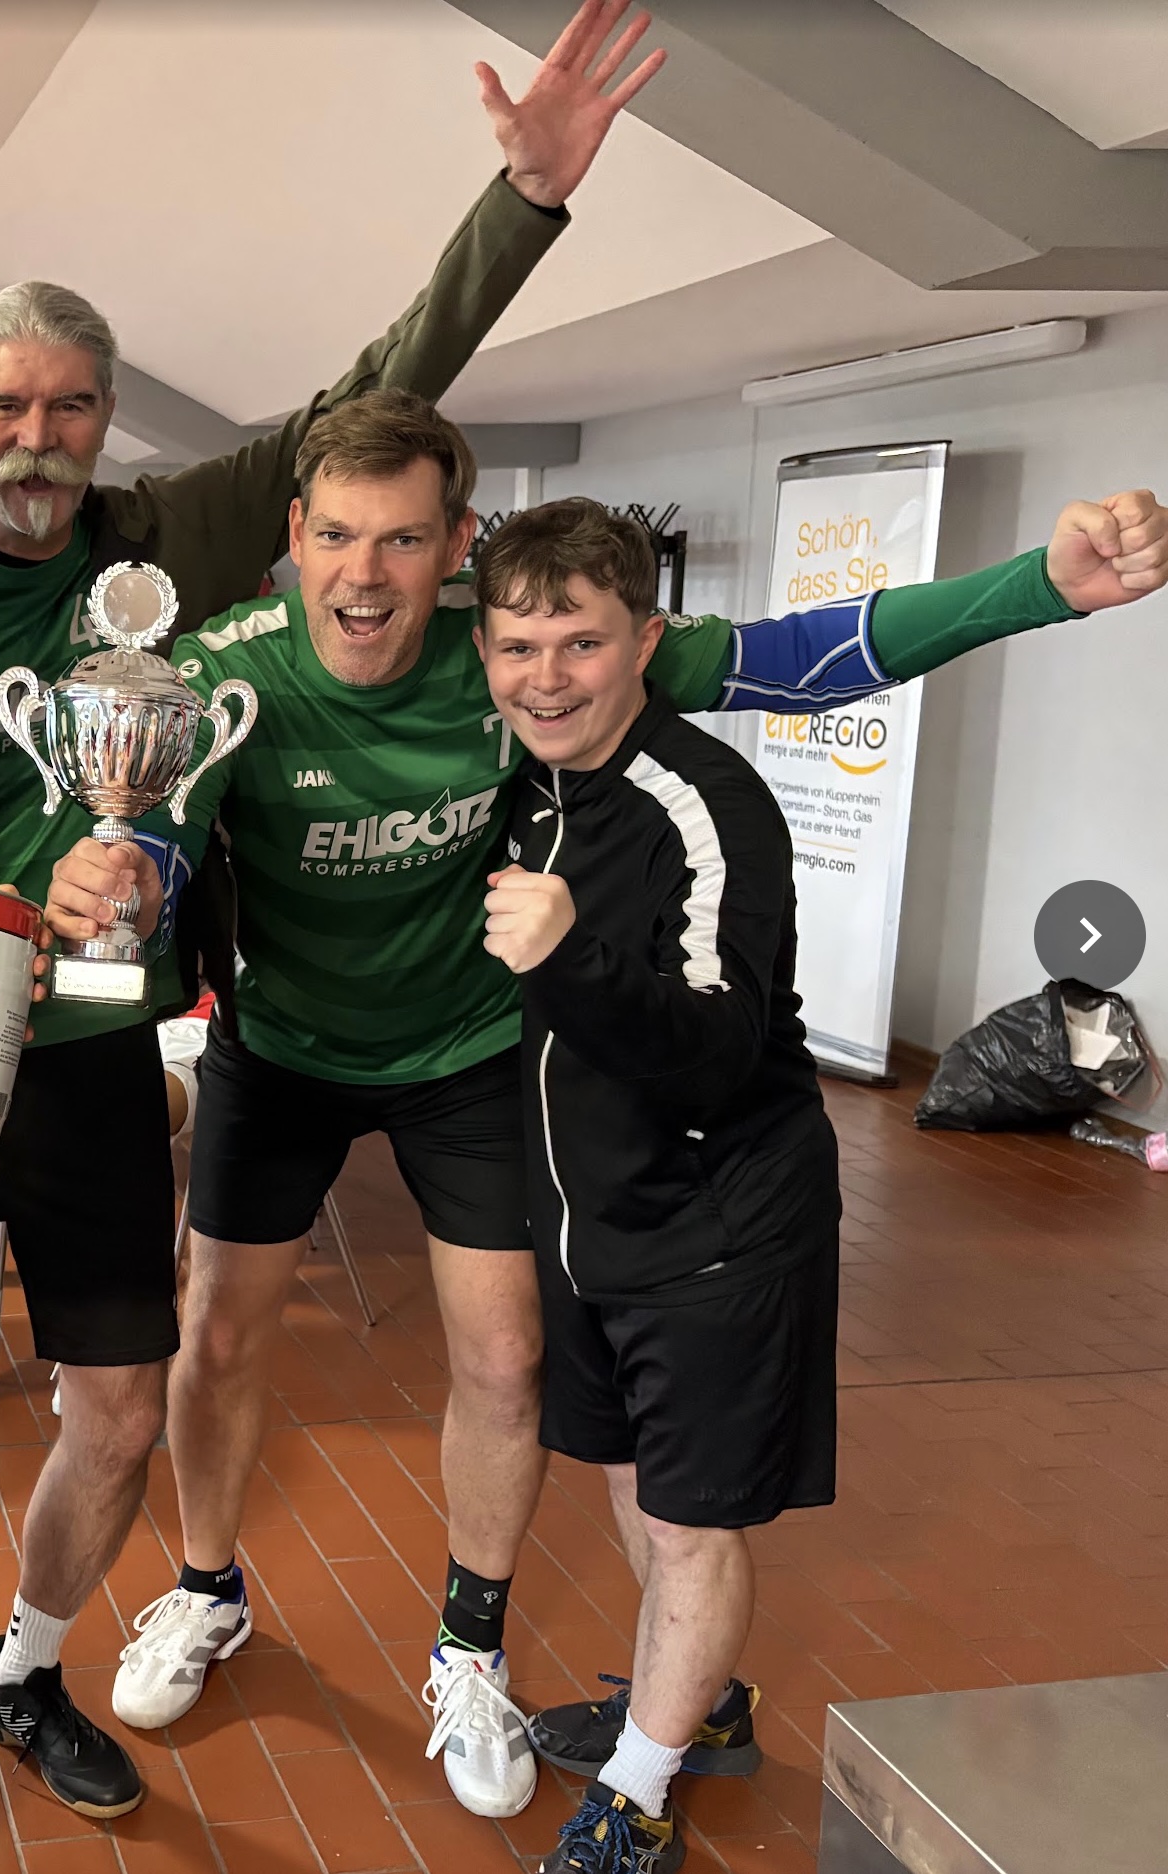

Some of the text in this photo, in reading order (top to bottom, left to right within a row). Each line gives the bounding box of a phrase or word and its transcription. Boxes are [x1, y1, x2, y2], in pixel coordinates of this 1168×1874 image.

[797, 514, 878, 558] Schön,
[787, 556, 888, 604] dass Sie
[764, 743, 829, 762] energie und mehr
[293, 769, 336, 789] JAKO
[853, 808, 873, 825] Gas
[300, 826, 487, 876] KOMPRESSOREN
[793, 851, 856, 874] eregio.com
